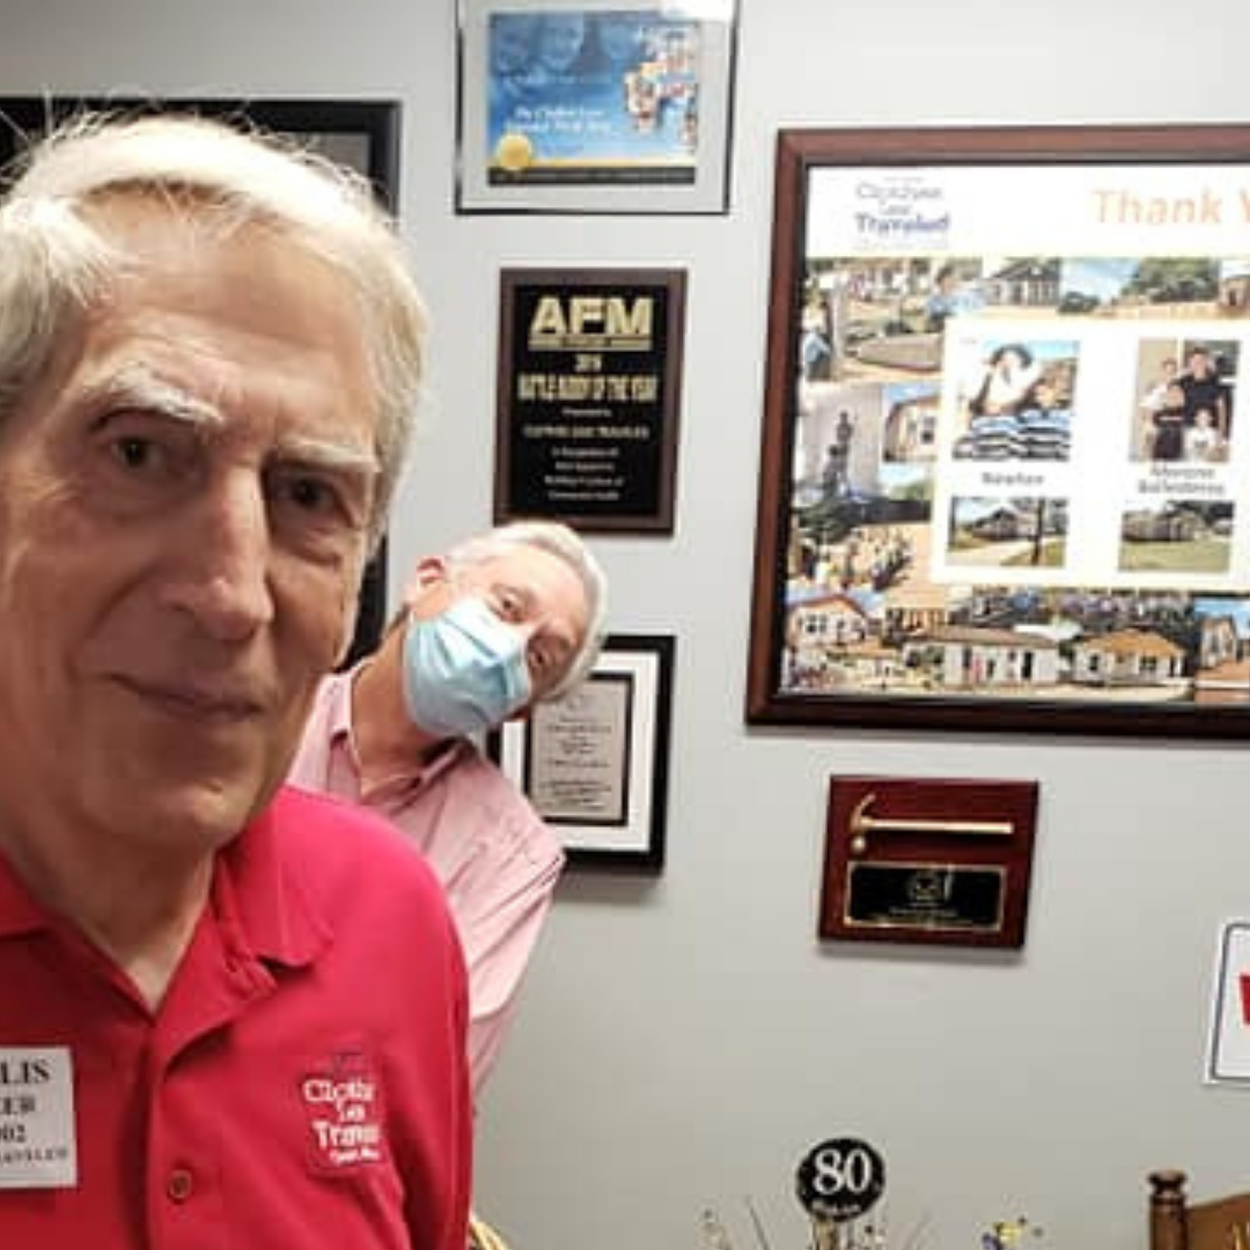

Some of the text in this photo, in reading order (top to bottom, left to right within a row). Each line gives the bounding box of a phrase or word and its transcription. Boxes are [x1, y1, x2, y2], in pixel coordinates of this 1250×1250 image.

[1090, 185, 1222, 225] Thank
[530, 297, 654, 335] AFM
[812, 1147, 873, 1196] 80
